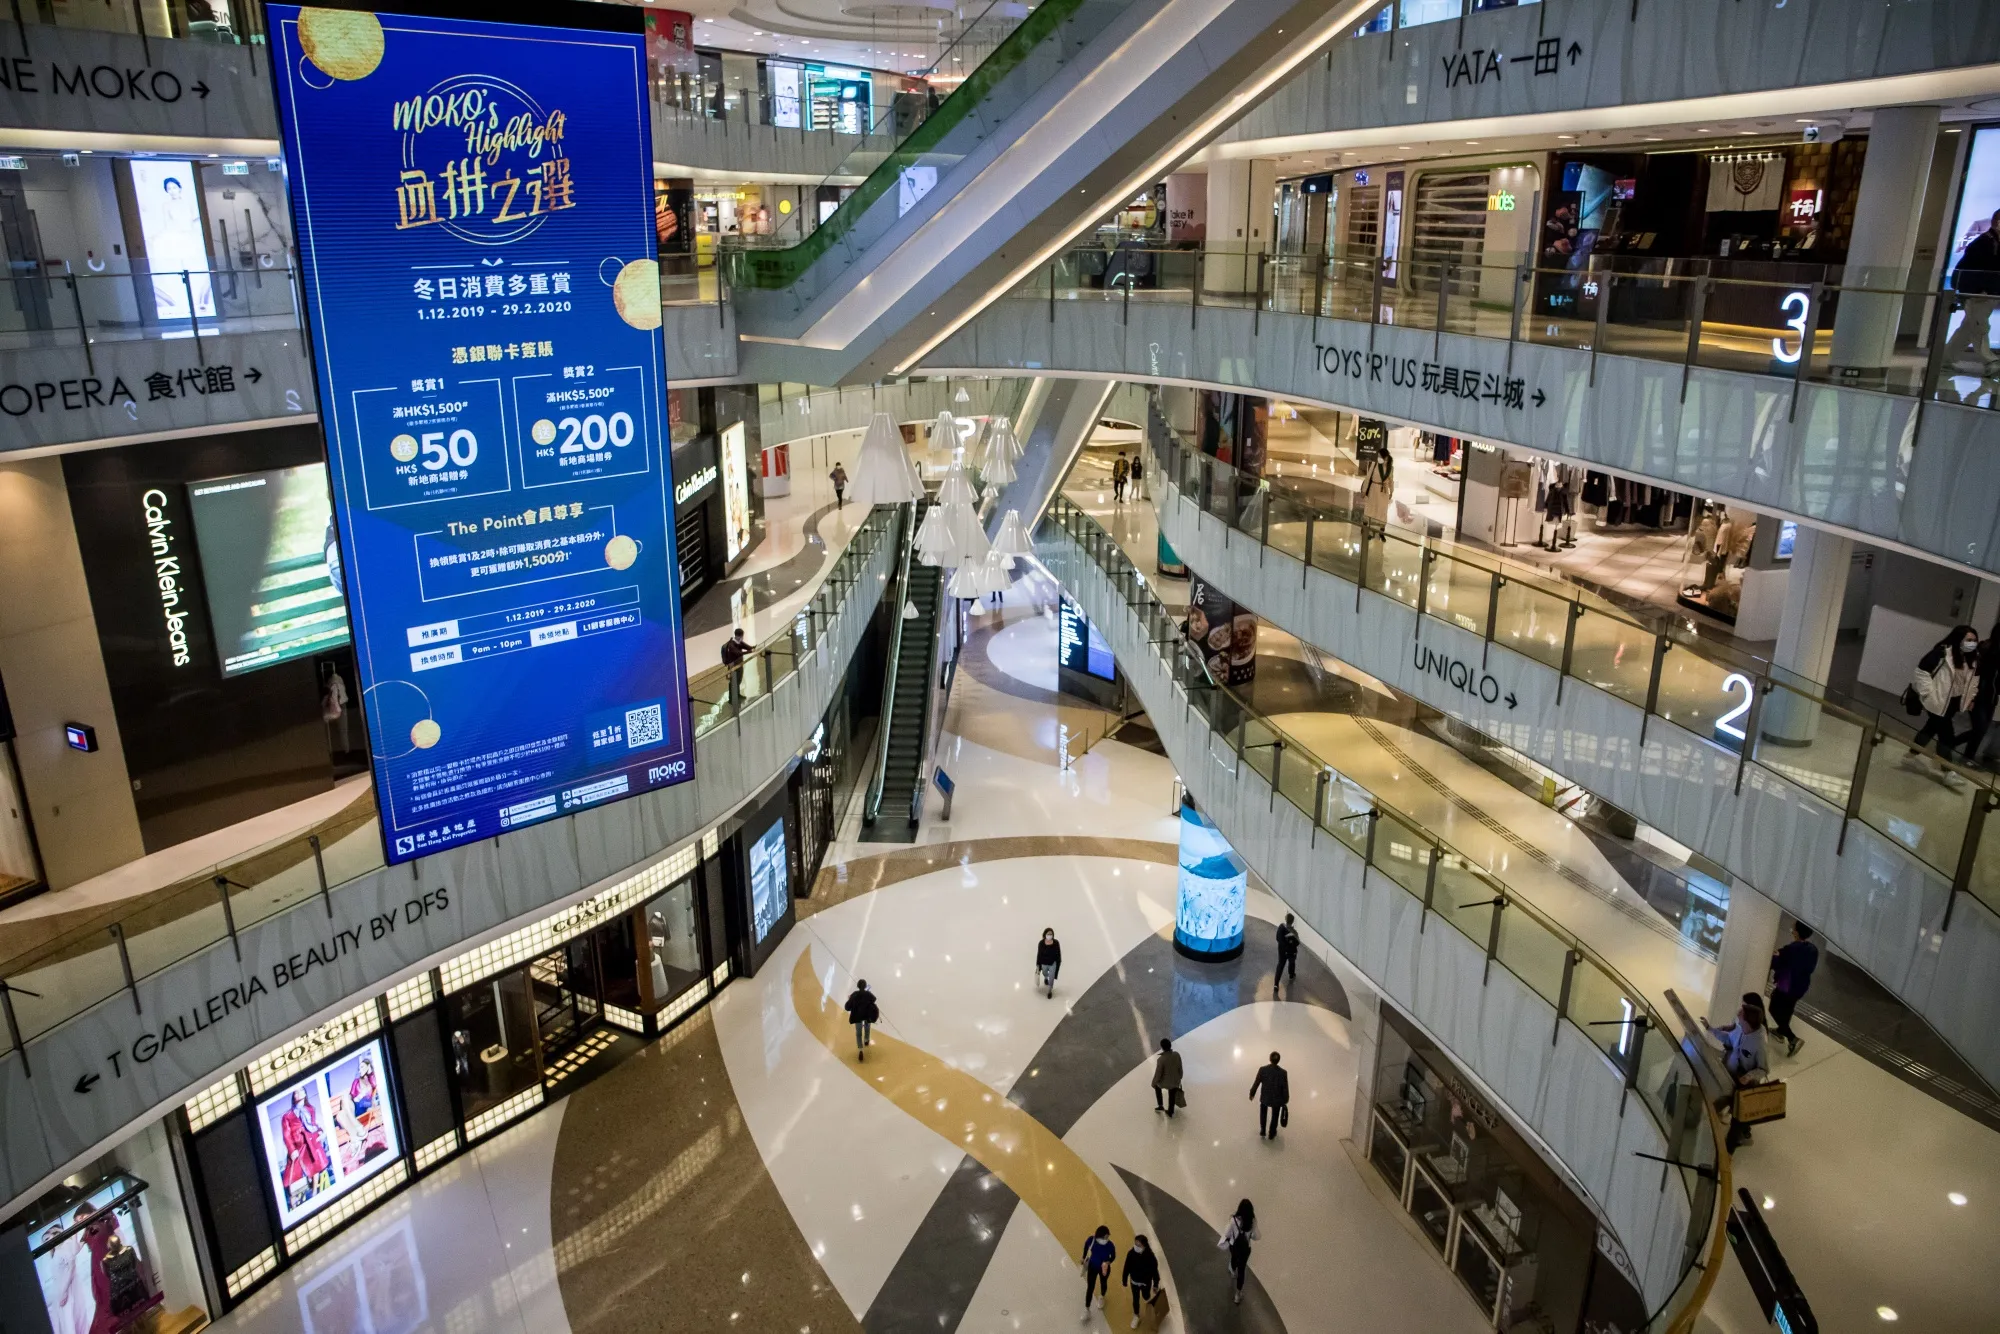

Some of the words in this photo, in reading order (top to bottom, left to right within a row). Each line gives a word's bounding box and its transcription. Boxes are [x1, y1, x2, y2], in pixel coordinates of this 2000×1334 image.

[53, 62, 182, 102] MOKO
[1442, 49, 1501, 88] YATA
[1510, 38, 1561, 76] 一田
[394, 89, 498, 133] MOKO's
[463, 109, 567, 165] Highlight
[395, 156, 577, 230] 血拼之選
[413, 272, 572, 300] 冬日消費多重賞
[417, 306, 485, 320] 1.12.2019
[502, 301, 572, 316] 29.2.2020
[1773, 292, 1810, 363] 3
[0, 376, 137, 417] OPERA
[144, 365, 237, 402] 食代館
[411, 377, 445, 393] 獎賞1
[563, 365, 595, 379] 獎賞2
[1315, 345, 1362, 379] TOYS
[1391, 358, 1417, 389] US
[1421, 362, 1526, 410] 玩具反斗城
[396, 464, 418, 475] HK$
[421, 429, 478, 470] 50
[536, 447, 555, 458] HK$
[558, 411, 634, 454] 200
[1359, 427, 1381, 441] 80%
[143, 489, 175, 556] Calvin
[447, 520, 478, 537] The
[154, 556, 185, 608] Klein
[505, 608, 545, 623] 1.12.2019
[554, 599, 596, 614] 29.2.2020
[165, 607, 191, 667] Jeans
[472, 644, 490, 655] 9am
[500, 638, 523, 650] 10pm
[1414, 646, 1499, 704] UNIQLO
[1715, 673, 1754, 740] 2
[648, 760, 686, 783] MOKO
[552, 894, 620, 933] COACH
[107, 1051, 123, 1078] T
[132, 975, 269, 1063] GALLERIA
[272, 925, 364, 988] BEAUTY
[370, 910, 397, 942] BY
[406, 887, 450, 925] DFS
[270, 1017, 360, 1072] COACH
